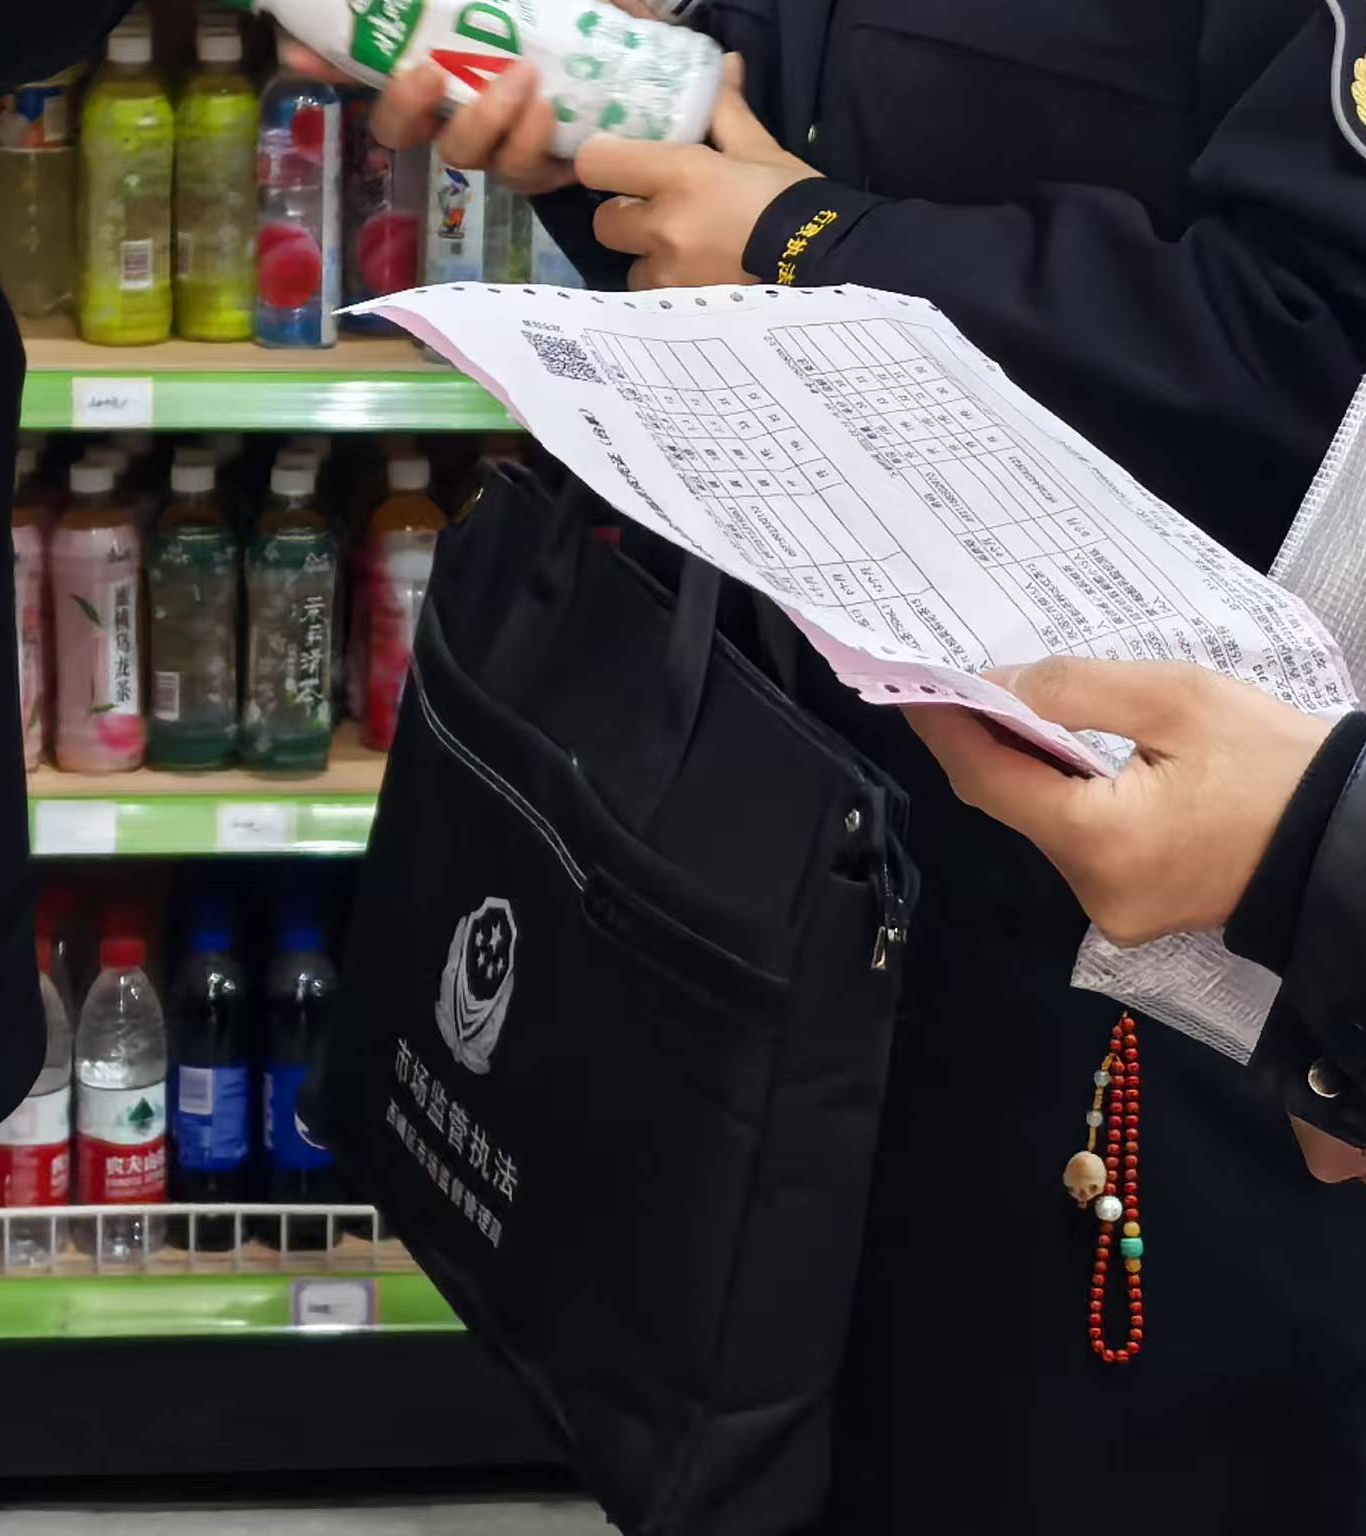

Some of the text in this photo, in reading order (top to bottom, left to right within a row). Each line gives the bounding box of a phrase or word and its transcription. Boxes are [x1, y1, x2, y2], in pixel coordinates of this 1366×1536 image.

[395, 1037, 518, 1203] 市场监管执法
